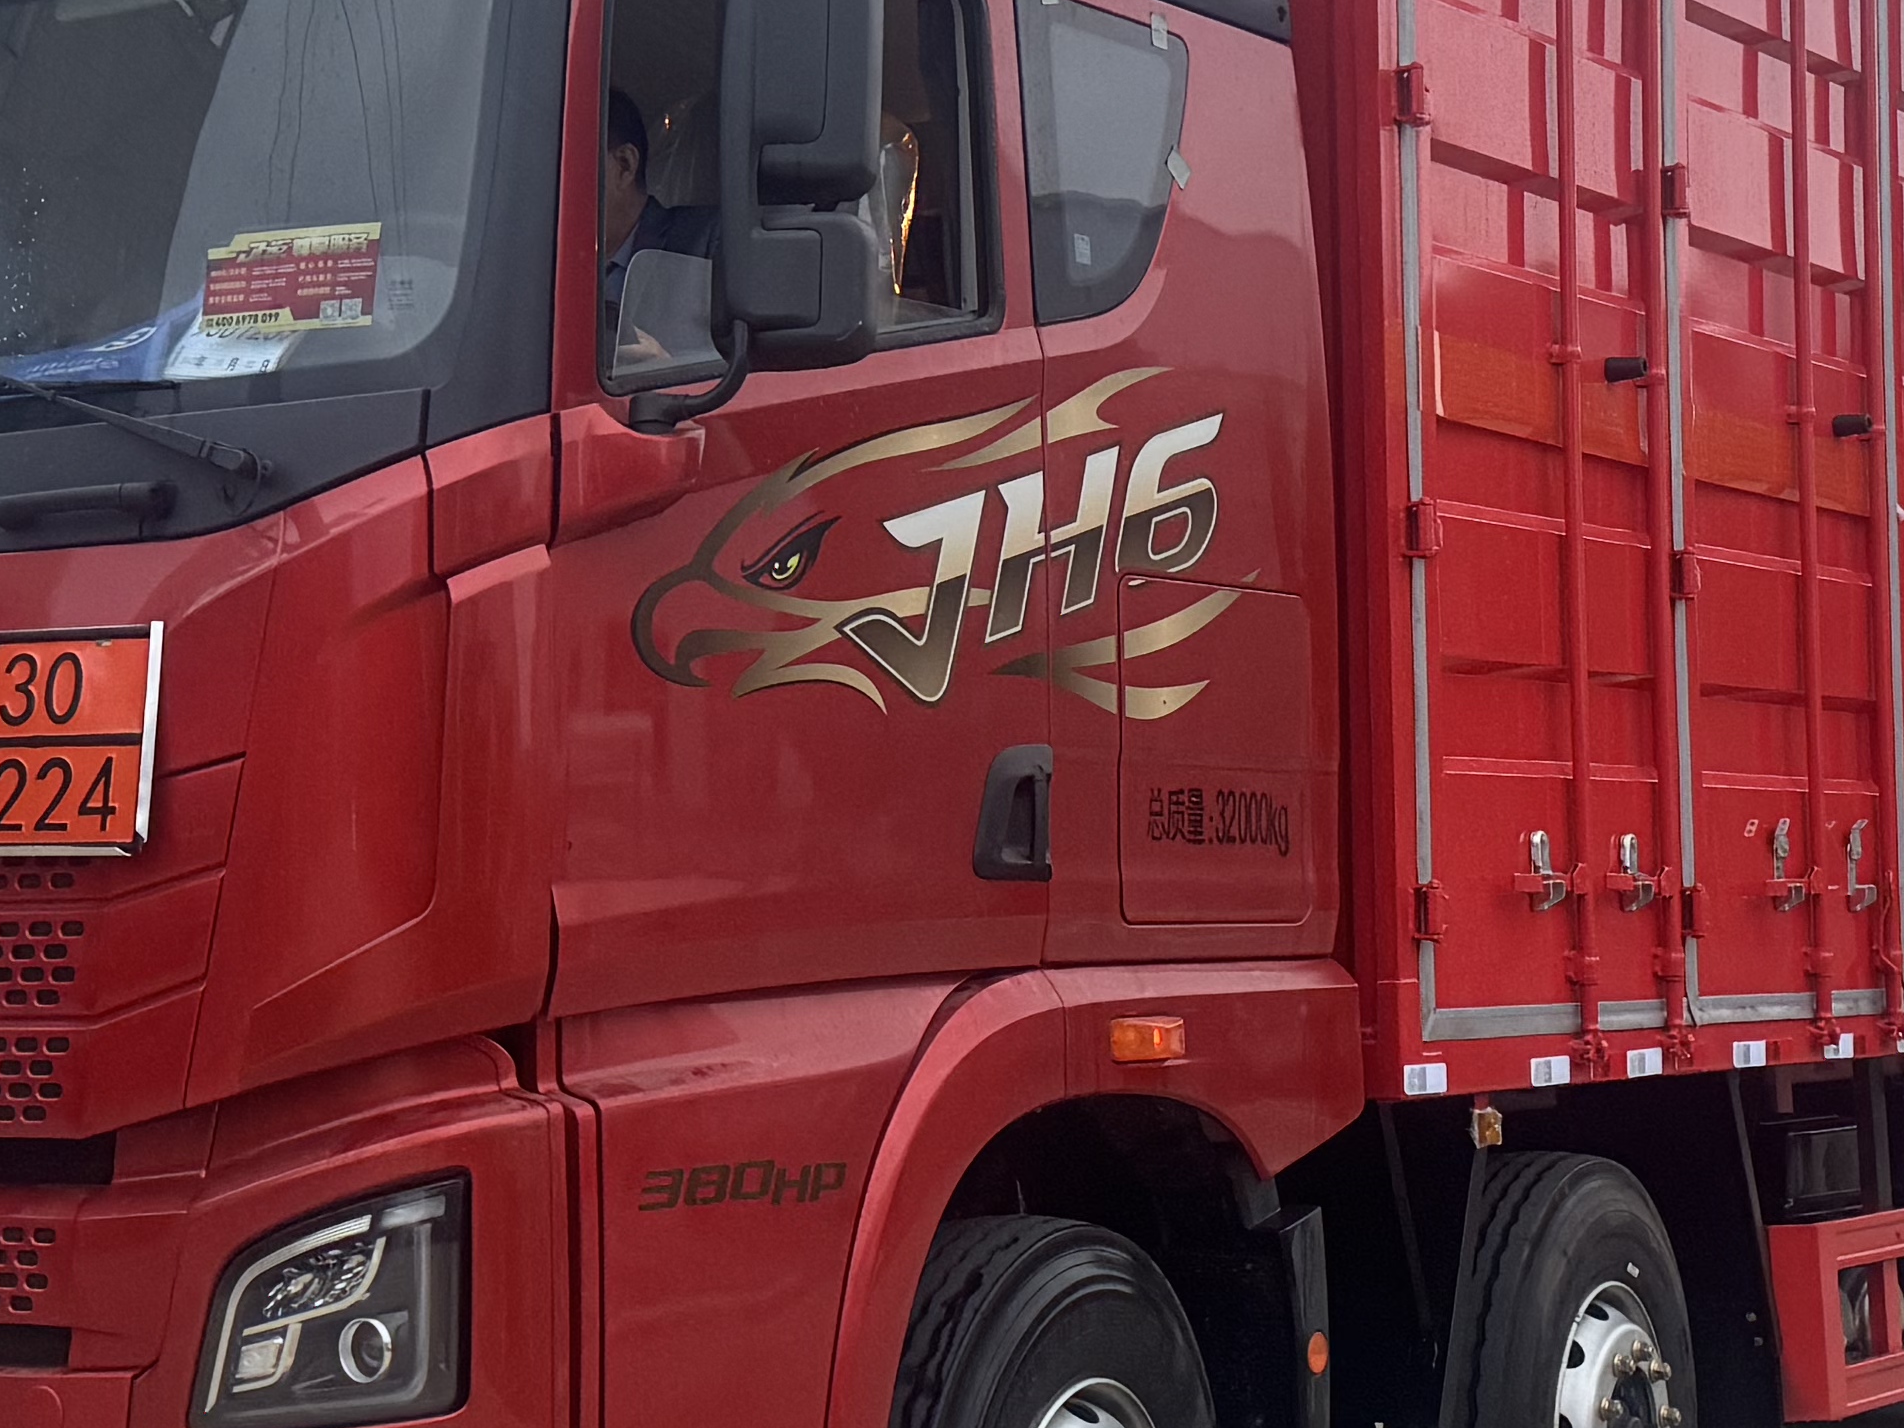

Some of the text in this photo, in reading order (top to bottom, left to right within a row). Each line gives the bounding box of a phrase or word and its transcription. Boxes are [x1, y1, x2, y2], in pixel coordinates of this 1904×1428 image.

[840, 413, 1224, 703] JH6
[0, 652, 83, 726] 30
[638, 1159, 847, 1212] 380HP
